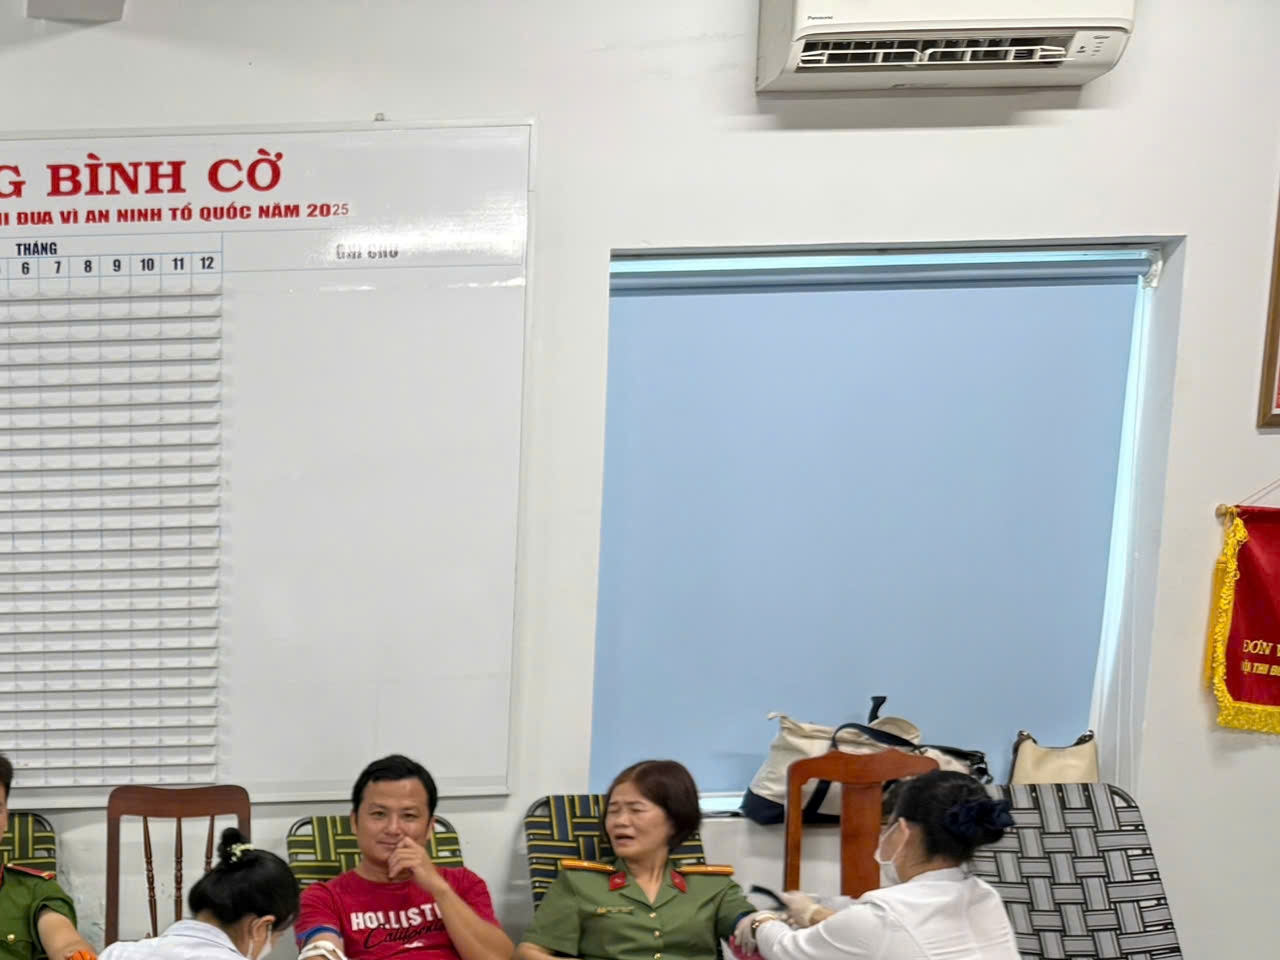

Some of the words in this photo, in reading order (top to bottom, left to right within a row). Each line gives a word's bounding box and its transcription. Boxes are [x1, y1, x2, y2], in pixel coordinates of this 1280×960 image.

[46, 152, 186, 197] BÌNH
[207, 148, 284, 193] CỜ
[16, 211, 54, 226] ĐUA
[60, 208, 79, 224] VÌ
[84, 209, 110, 224] AN
[116, 207, 162, 223] NINH
[199, 201, 252, 221] QUỐC
[258, 202, 300, 219] NĂM
[306, 202, 349, 218] 2025
[15, 242, 58, 256] THÁNG
[21, 262, 30, 275] 6
[54, 261, 61, 274] 7
[84, 260, 93, 273] 8
[113, 259, 121, 272] 9
[140, 258, 155, 271] 10
[172, 257, 184, 271] 11
[200, 257, 214, 270] 12
[350, 902, 443, 931] HOLLIST
